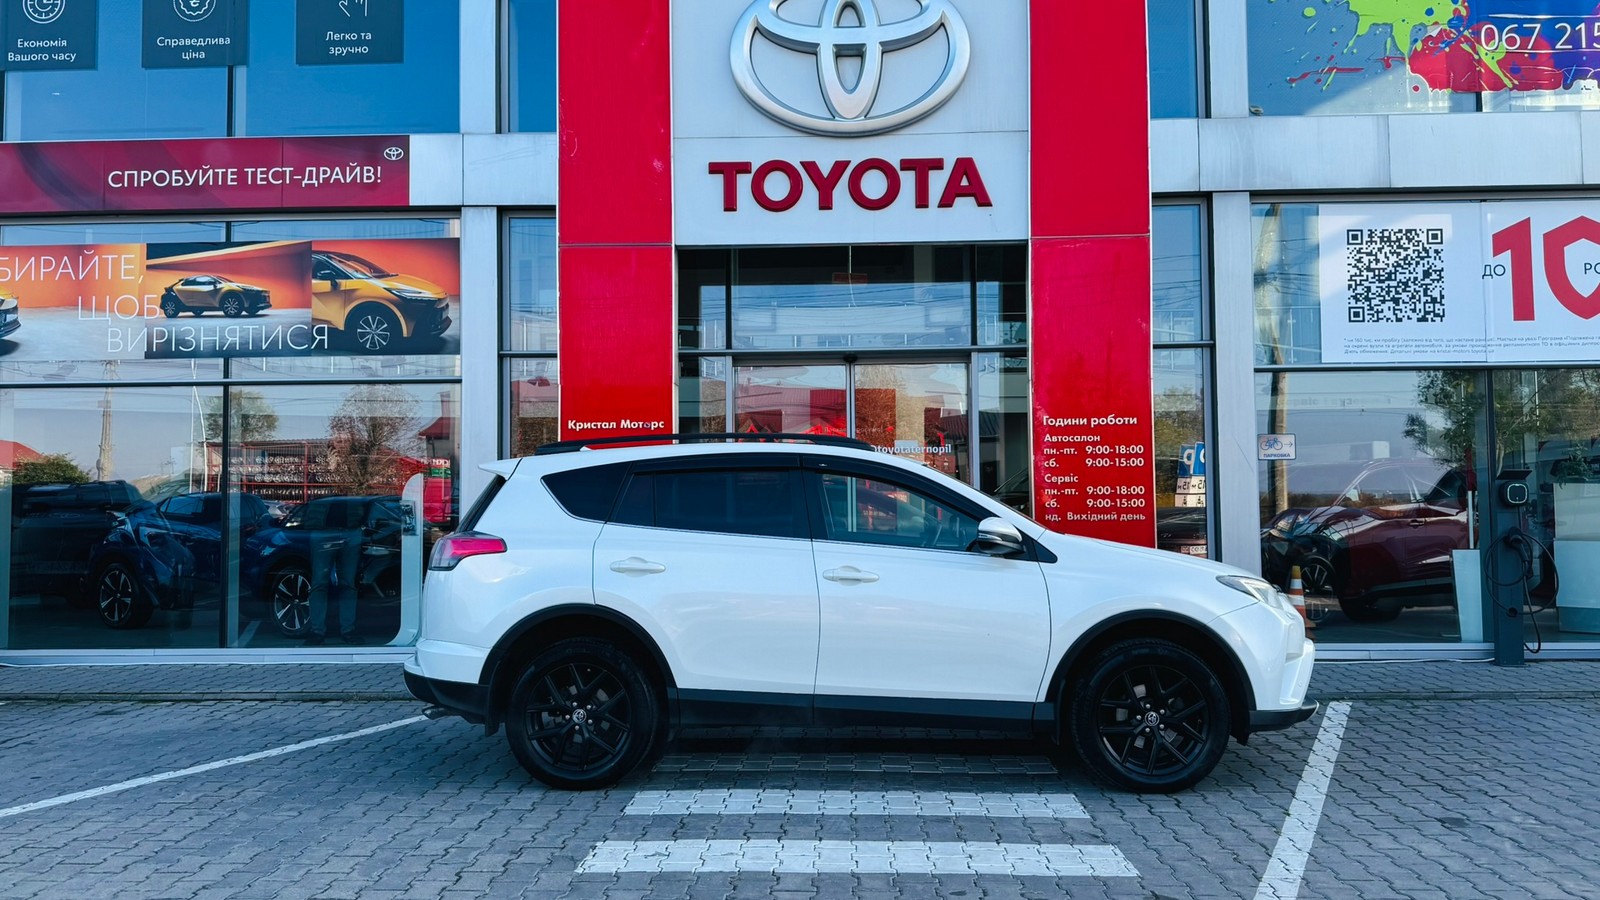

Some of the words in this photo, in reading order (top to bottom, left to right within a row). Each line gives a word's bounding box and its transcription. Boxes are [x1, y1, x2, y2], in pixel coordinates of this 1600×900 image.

[325, 31, 357, 41] Легко
[360, 32, 372, 40] та
[1481, 23, 1541, 50] 067
[17, 37, 67, 48] Економія
[157, 36, 231, 48] Справедлива
[182, 50, 205, 60] ціна
[328, 46, 369, 56] зручно
[8, 52, 49, 62] Вашого
[52, 52, 76, 62] часу
[108, 165, 238, 188] СПРОБУЙТЕ
[244, 162, 382, 188] ТЕСТ-ДРАЙВ!
[708, 157, 993, 212] TOYOTA
[1482, 264, 1506, 279] ДО
[78, 294, 160, 323] ЩОБ
[107, 324, 329, 352] ВИРІЗНЯТИСЯ
[568, 420, 616, 431] Кристал
[620, 419, 664, 430] Моторс
[1043, 416, 1087, 427] Години
[1091, 414, 1137, 428] роботи
[1044, 434, 1100, 442] Автосалон
[1043, 447, 1078, 455] пн.-пт.
[1085, 445, 1144, 454] 9:00-18:00
[1044, 458, 1059, 467] сб.
[1085, 458, 1144, 467] 9:00-15:00
[1044, 473, 1079, 484] Сервіс
[1086, 486, 1145, 495] 9:00-18:00
[1045, 499, 1060, 508] сб.
[1086, 499, 1145, 508] 9:00-15:00
[1067, 511, 1117, 521] Вихідний
[1120, 513, 1146, 521] день
